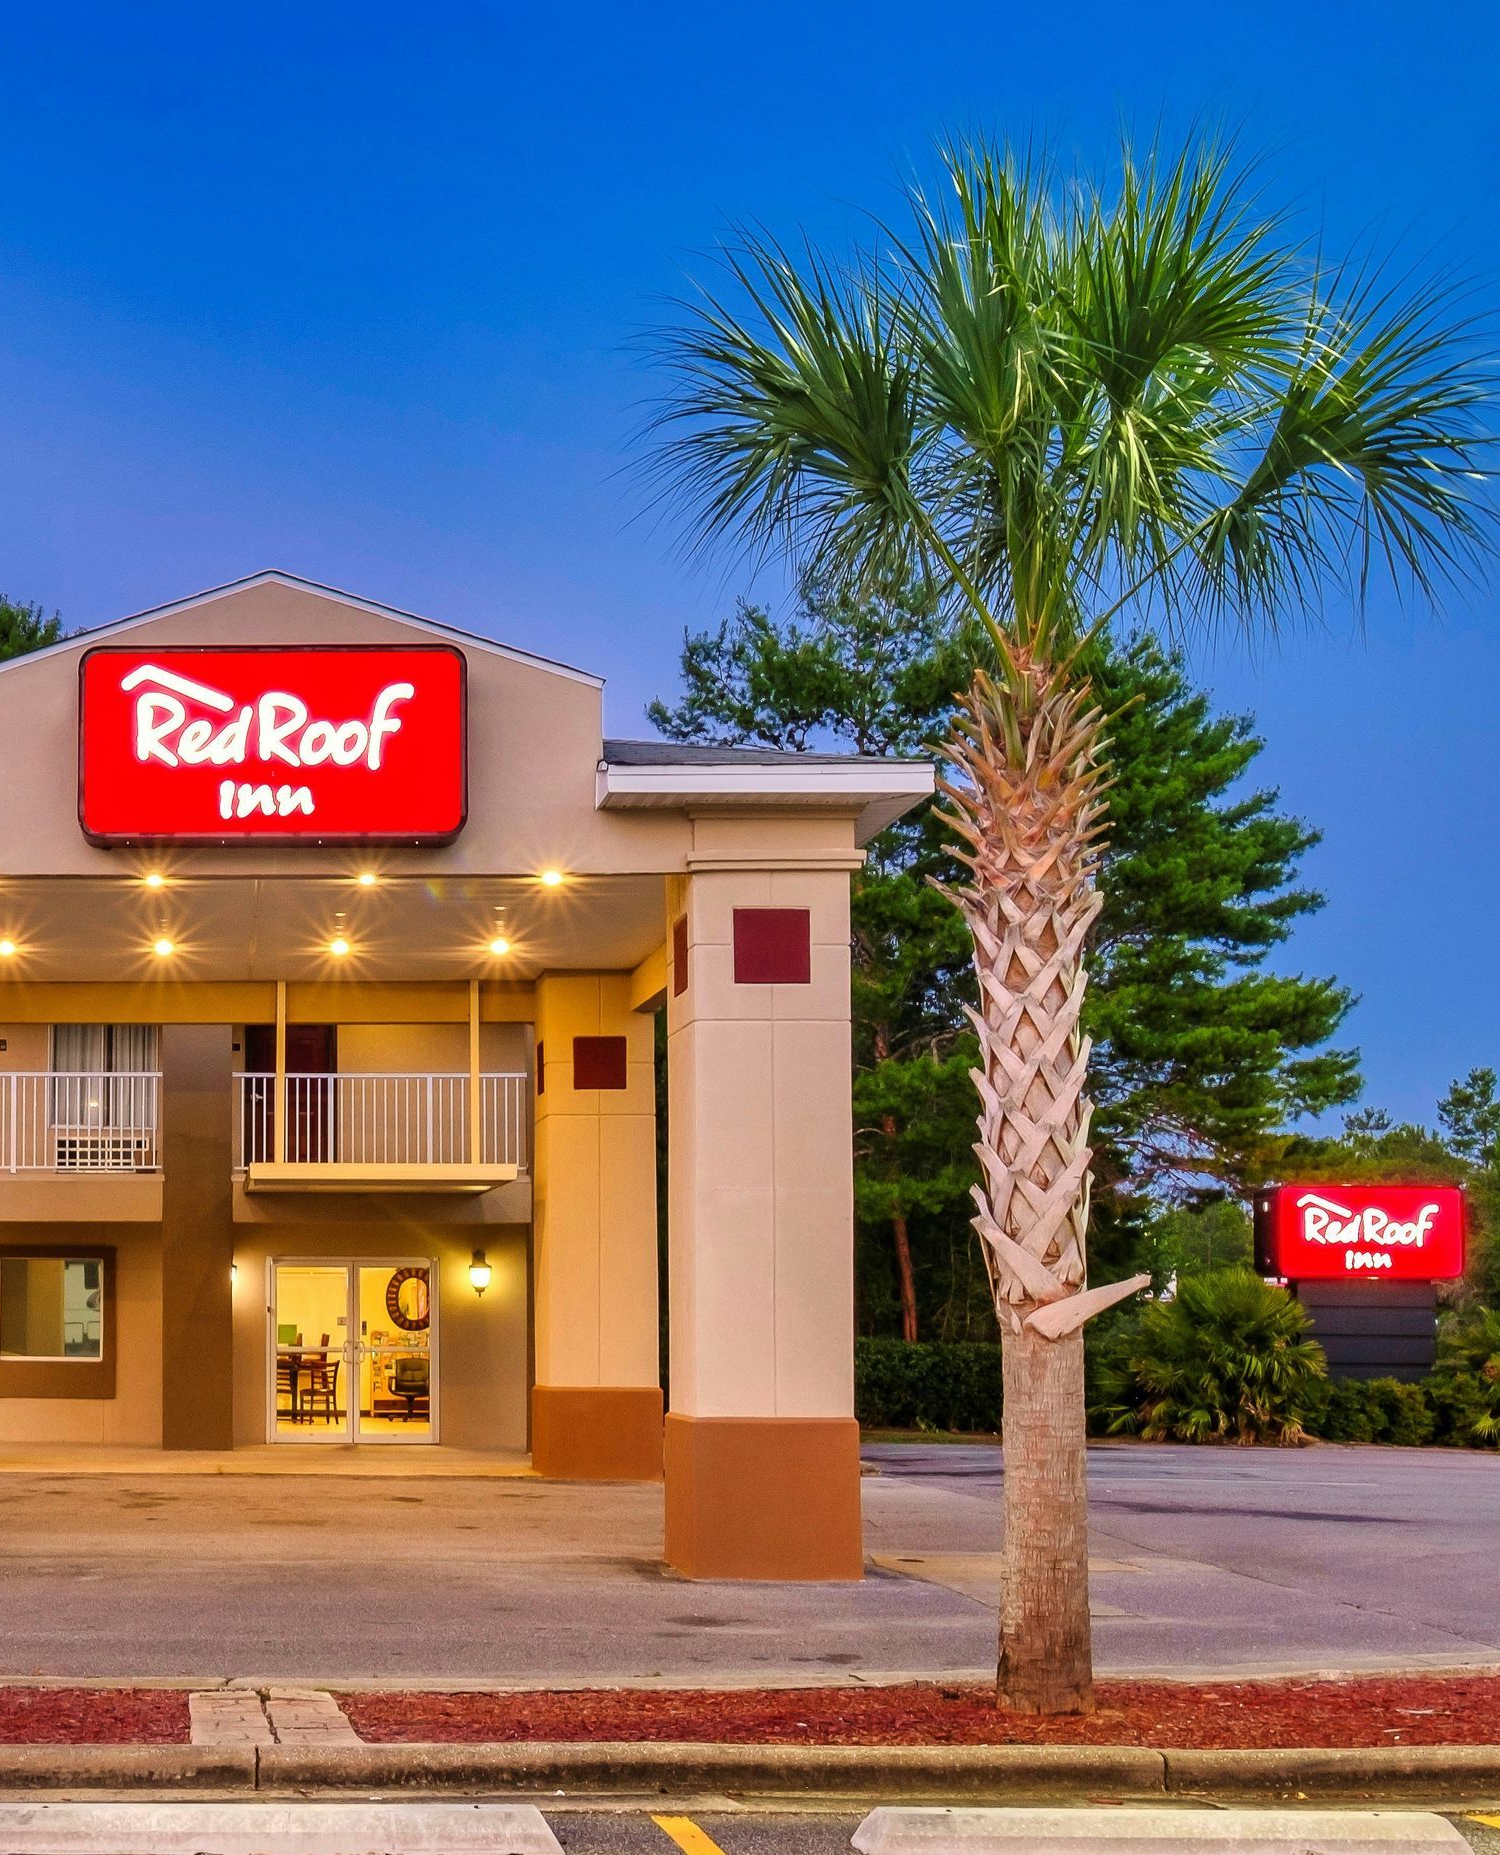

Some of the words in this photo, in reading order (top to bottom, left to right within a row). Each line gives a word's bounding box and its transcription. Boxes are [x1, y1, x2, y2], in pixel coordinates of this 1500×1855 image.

[136, 691, 254, 768] Red
[258, 682, 416, 771] Roof
[219, 780, 316, 820] Inn
[1304, 1206, 1362, 1245] Red
[1362, 1204, 1439, 1248] Roof
[1345, 1250, 1393, 1270] Inn
